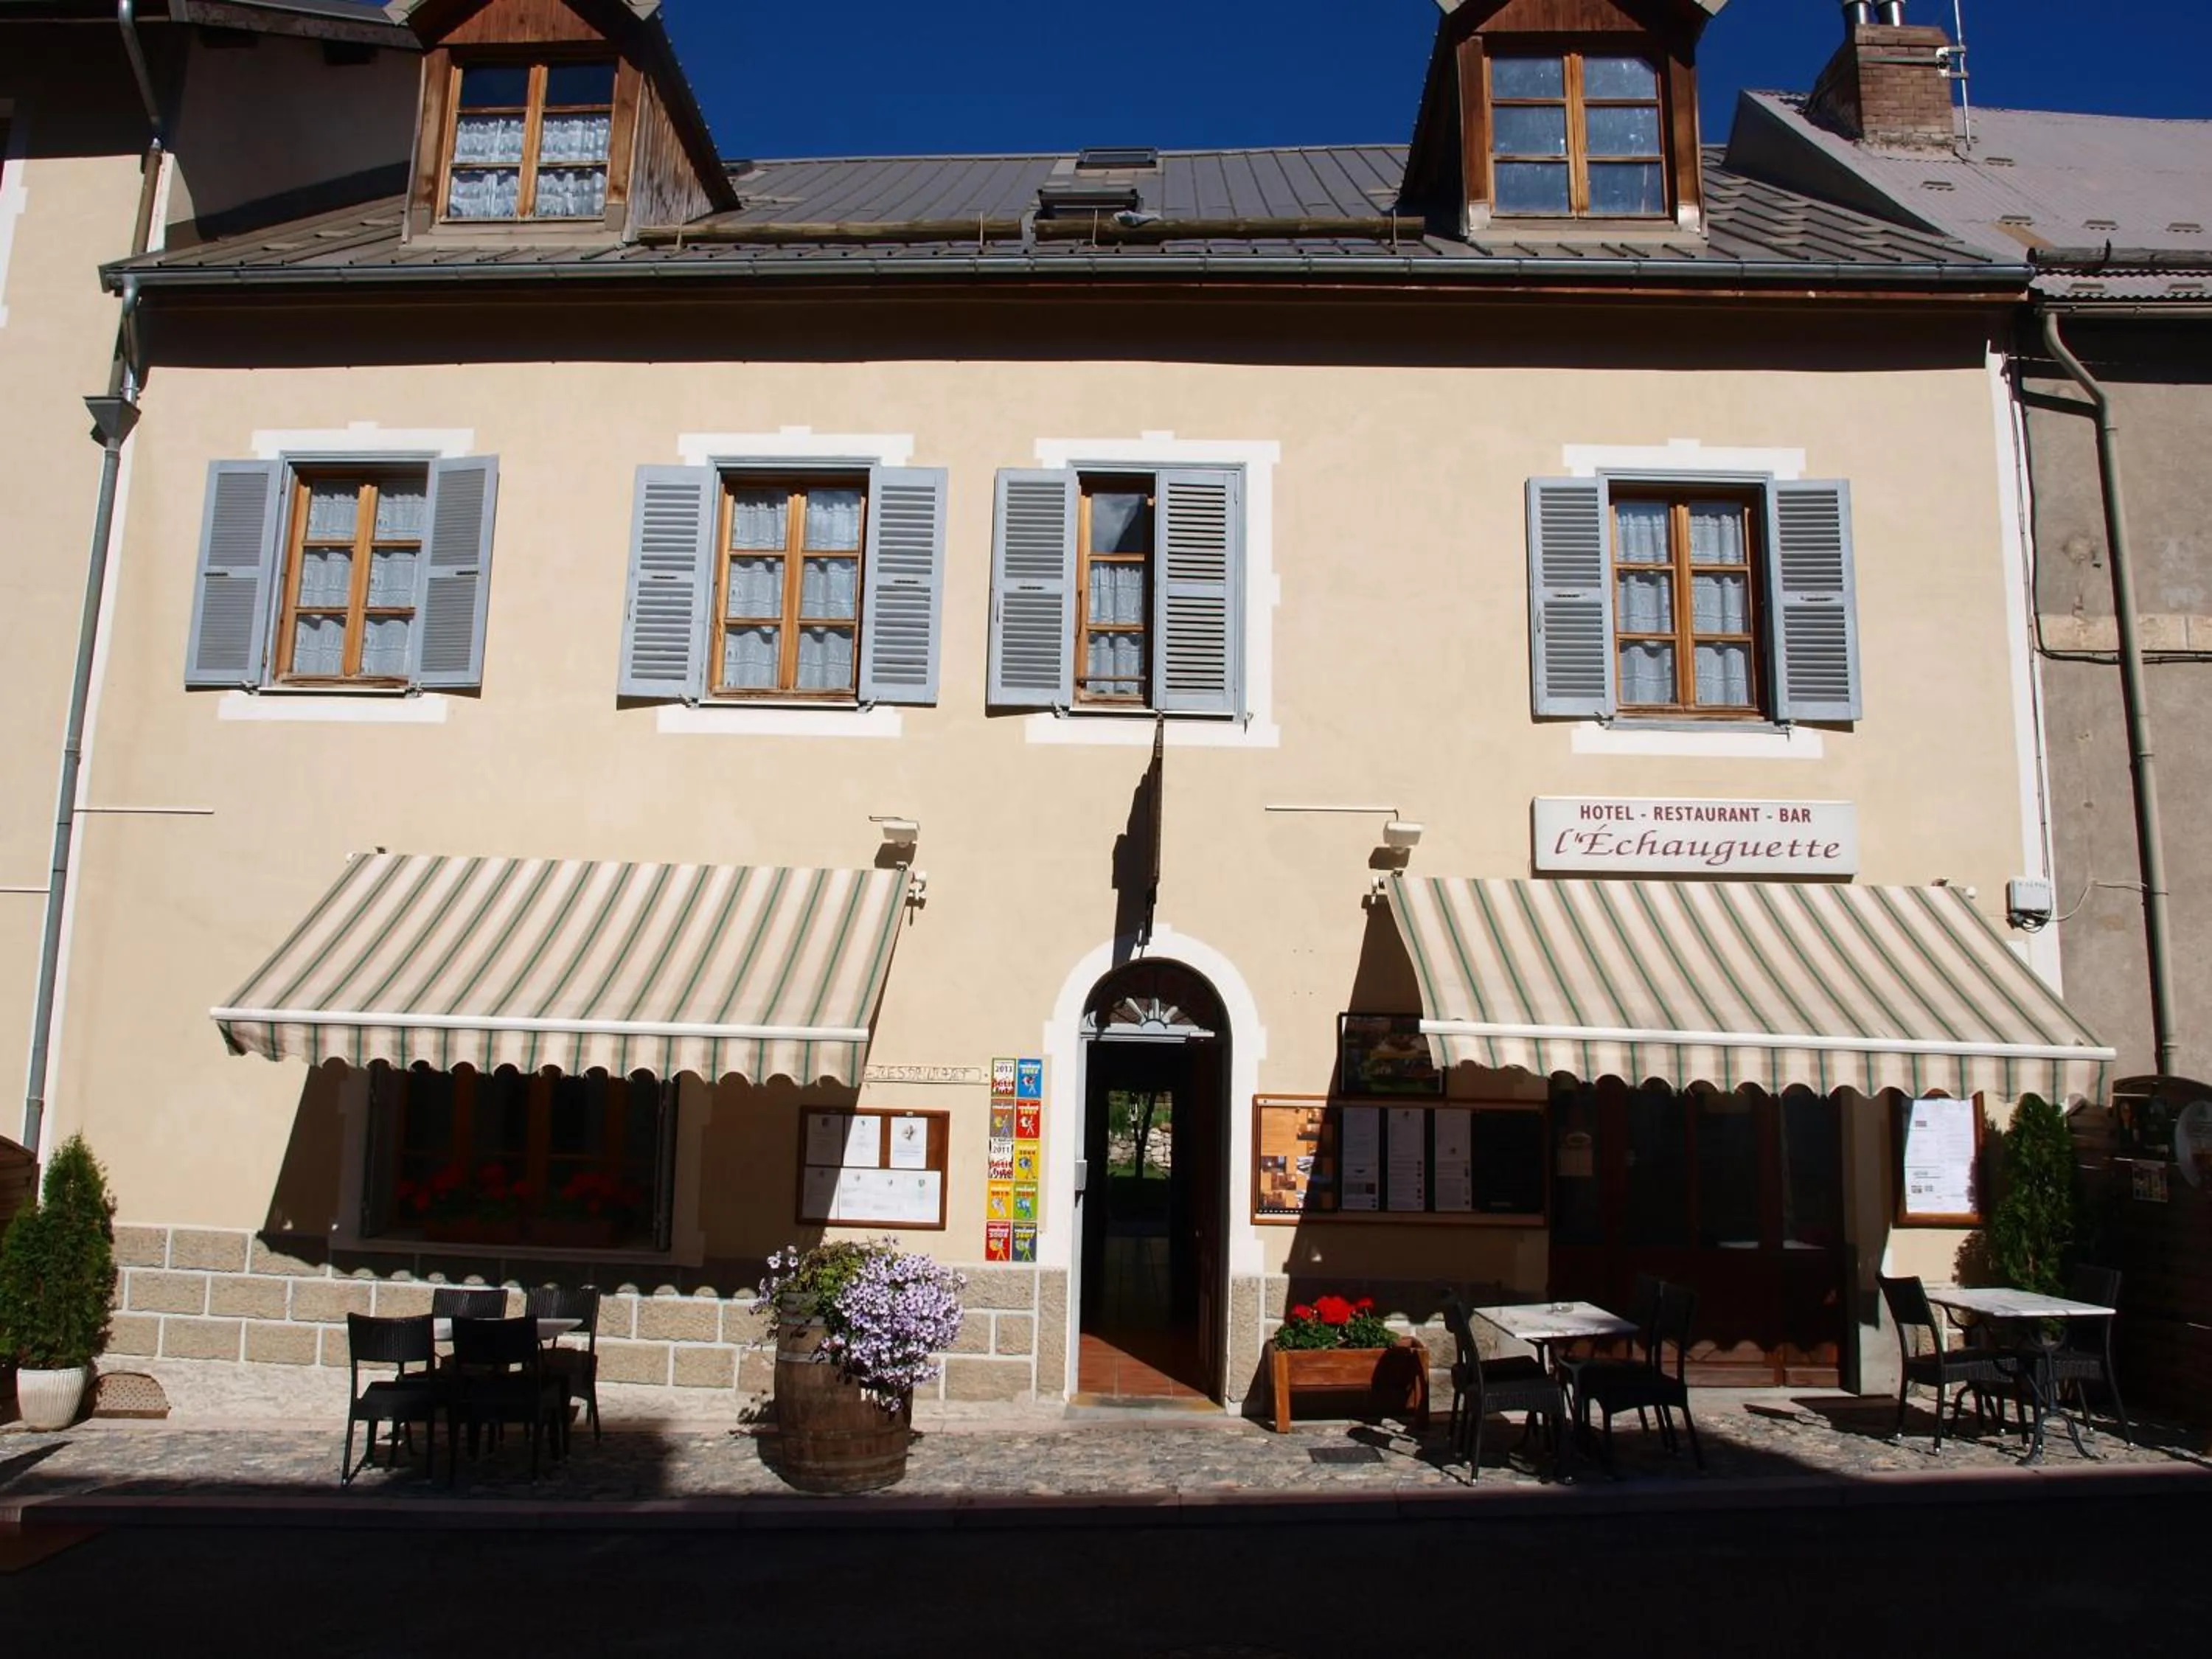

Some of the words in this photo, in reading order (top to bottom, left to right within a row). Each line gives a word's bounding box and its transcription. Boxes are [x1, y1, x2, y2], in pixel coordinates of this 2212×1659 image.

[1579, 804, 1635, 821] HOTEL
[1653, 806, 1760, 823] RESTAURANT
[1779, 807, 1812, 824] BAR
[1554, 824, 1841, 866] l'Échauguette
